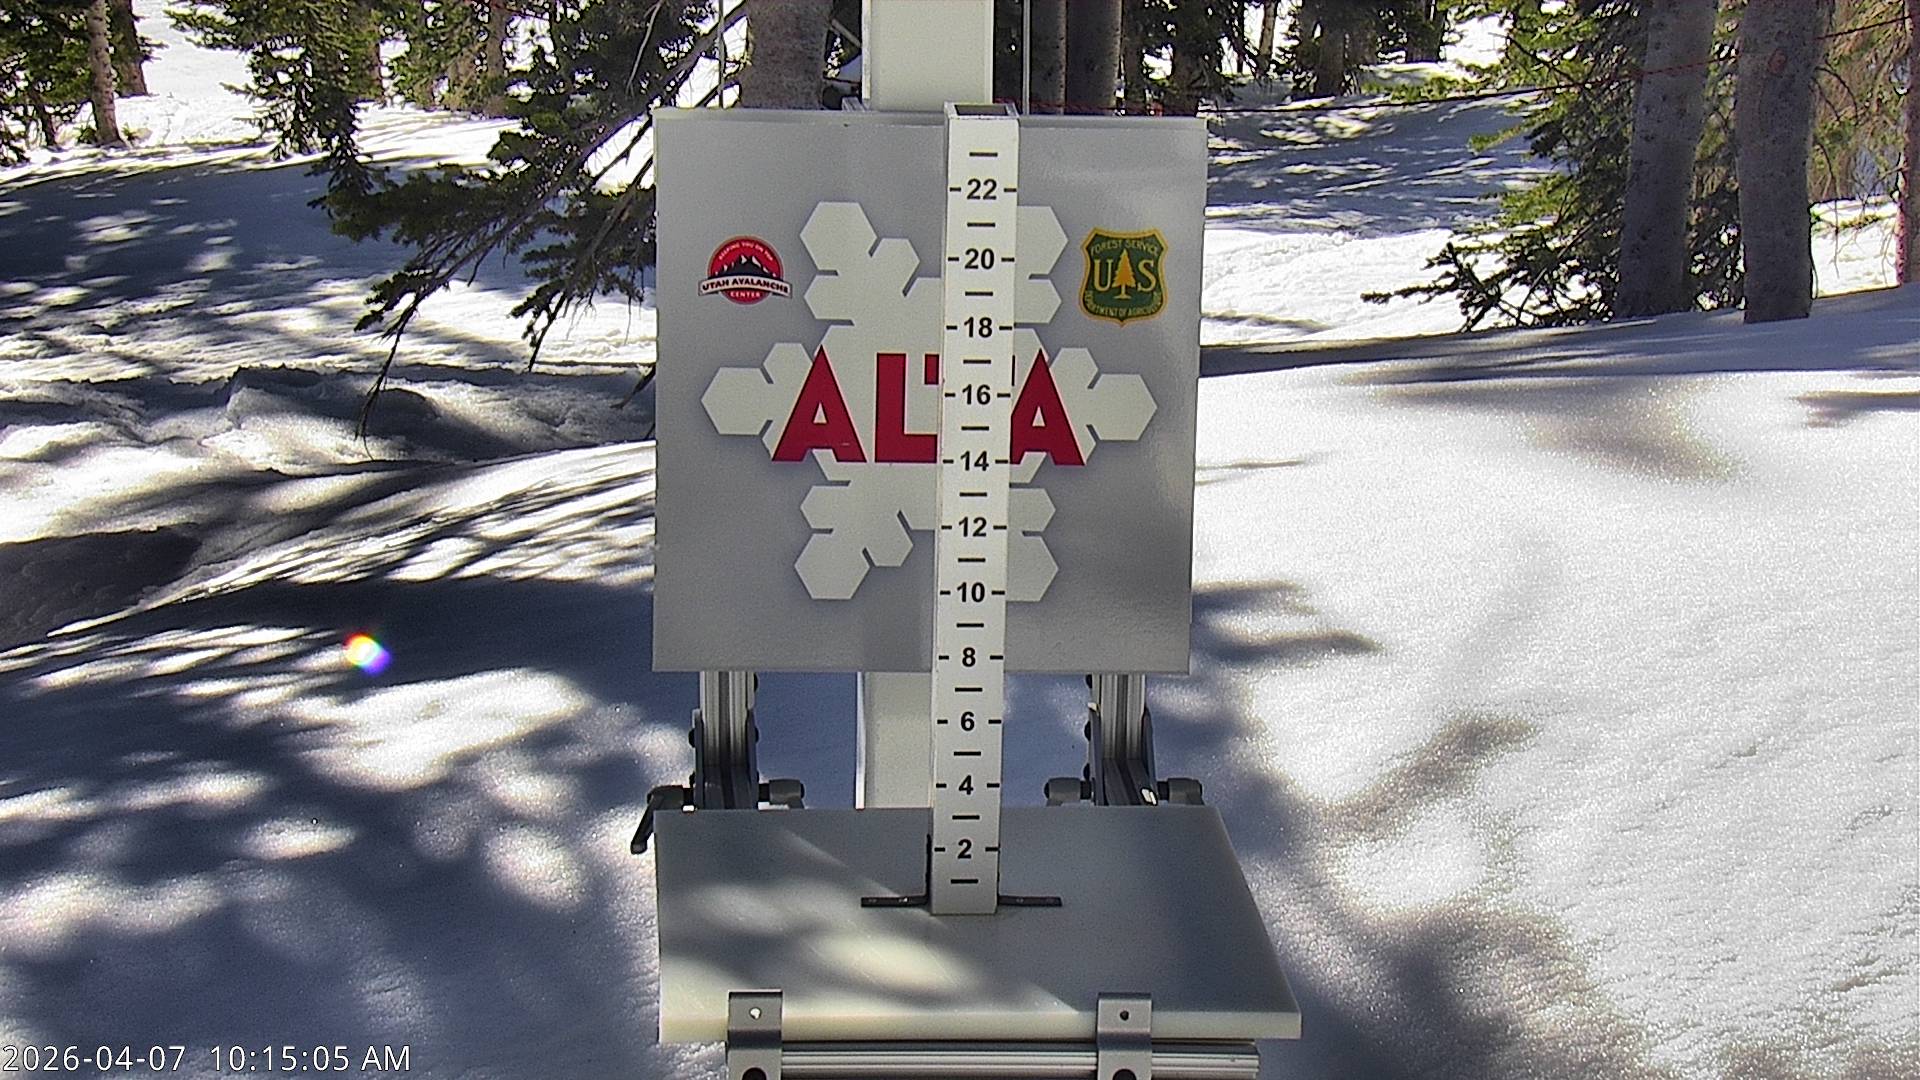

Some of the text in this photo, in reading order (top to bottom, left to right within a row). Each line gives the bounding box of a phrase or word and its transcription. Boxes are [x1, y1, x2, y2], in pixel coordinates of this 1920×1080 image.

[966, 178, 998, 200] 22
[1091, 239, 1159, 256] FOREST SERVICE
[965, 248, 995, 270] 20
[702, 278, 789, 293] UTAH AVALANCHE
[963, 316, 993, 338] 18
[772, 344, 1085, 465] ALA
[962, 384, 991, 405] 16
[960, 451, 989, 472] 14
[958, 517, 987, 538] 12
[957, 582, 986, 603] 10
[961, 647, 976, 667] 8
[960, 711, 974, 732] 6
[959, 775, 973, 795] 4
[957, 839, 972, 859] 2
